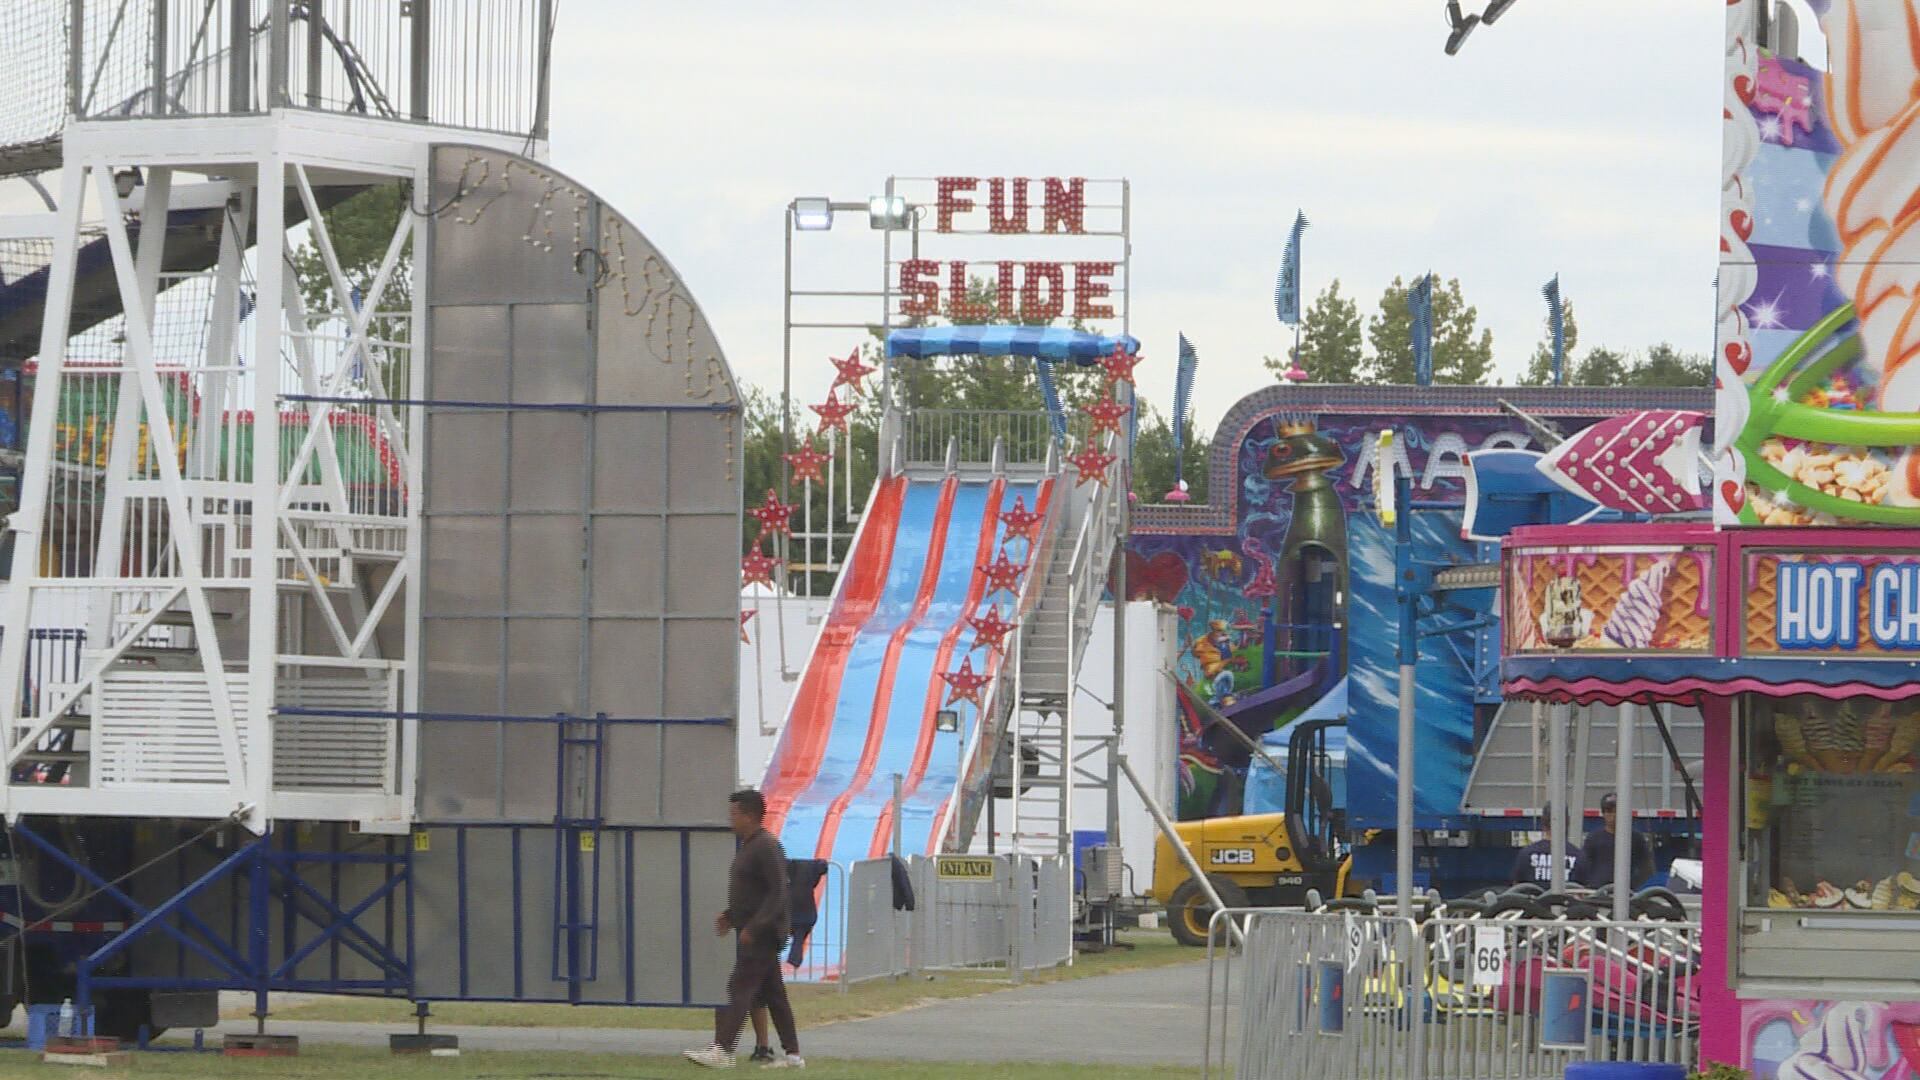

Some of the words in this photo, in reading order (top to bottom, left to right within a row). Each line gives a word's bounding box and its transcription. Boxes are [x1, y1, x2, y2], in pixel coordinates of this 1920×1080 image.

[937, 177, 1085, 233] FUN
[899, 260, 1115, 318] SLIDE
[1779, 565, 1860, 643] HOT
[416, 834, 427, 849] 11
[582, 834, 594, 849] 12
[1211, 849, 1254, 863] JCB
[1531, 853, 1576, 869] SAFY
[942, 861, 990, 875] ENTRANCE
[1535, 867, 1571, 881] FIRT
[1478, 947, 1500, 972] 66
